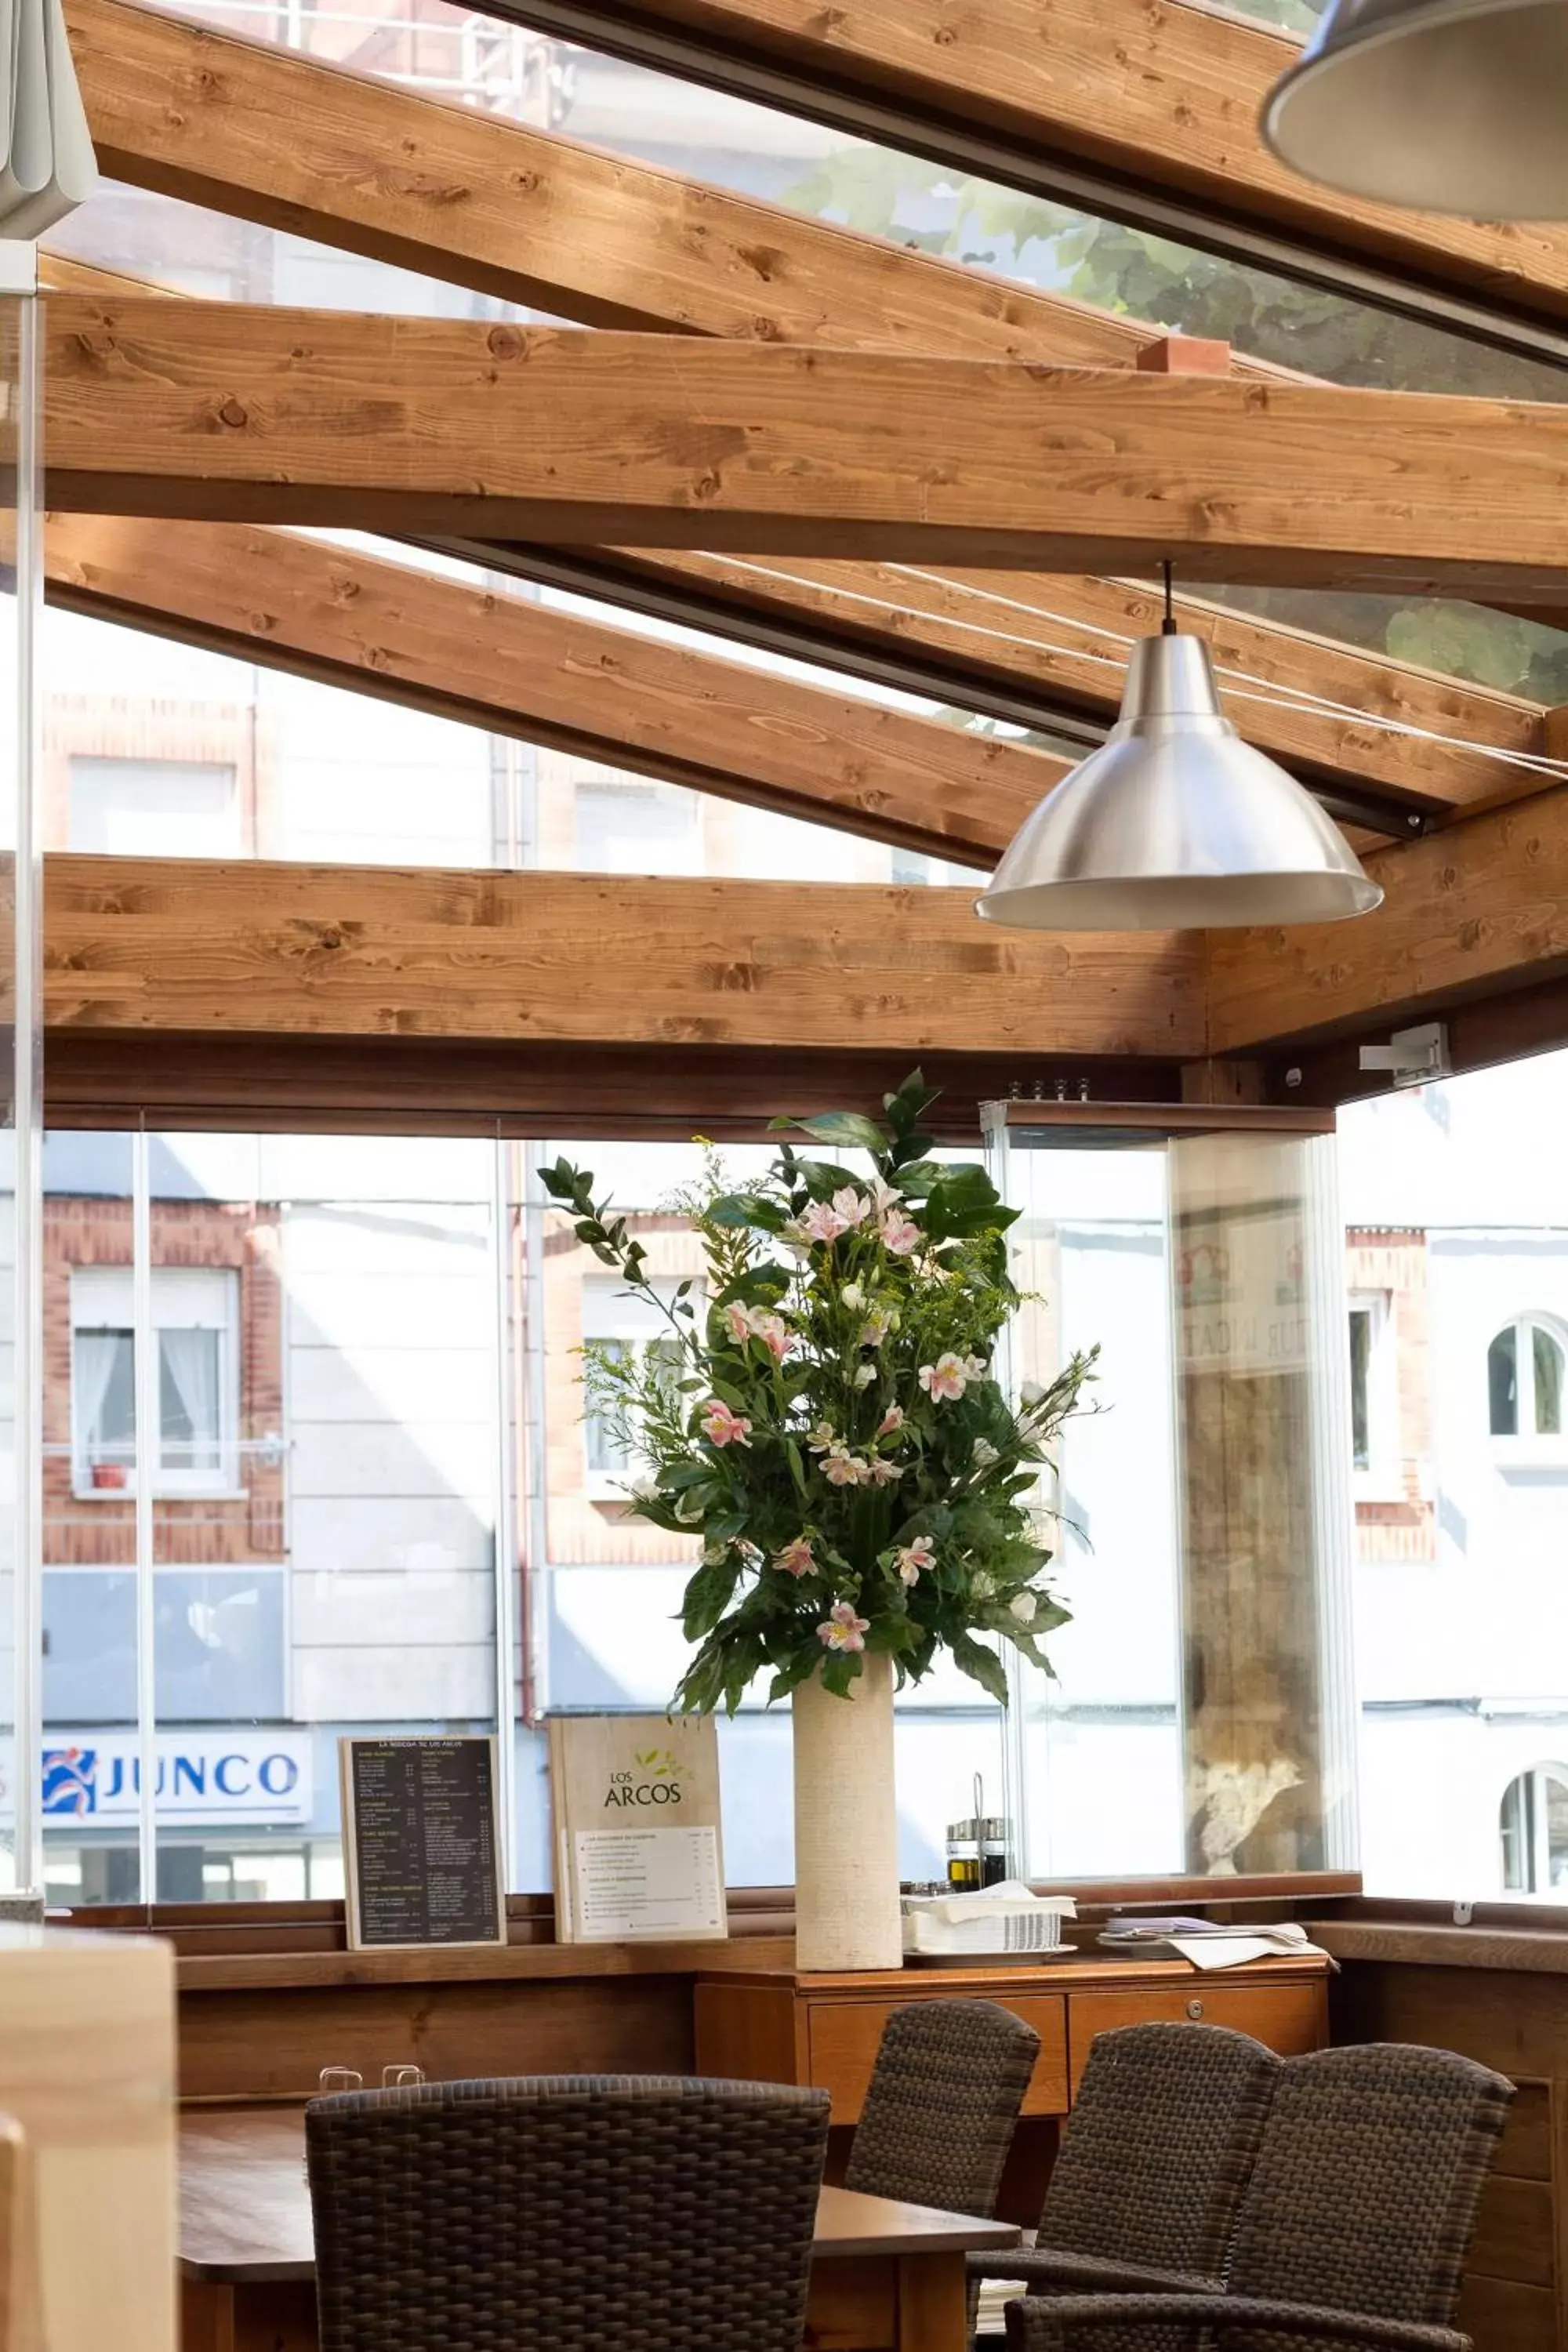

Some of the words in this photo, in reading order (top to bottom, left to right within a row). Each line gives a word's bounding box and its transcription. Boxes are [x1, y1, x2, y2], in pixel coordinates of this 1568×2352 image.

[103, 1754, 299, 1797] JUNCO
[610, 1771, 633, 1784] LOS
[604, 1783, 681, 1807] ARCOS
